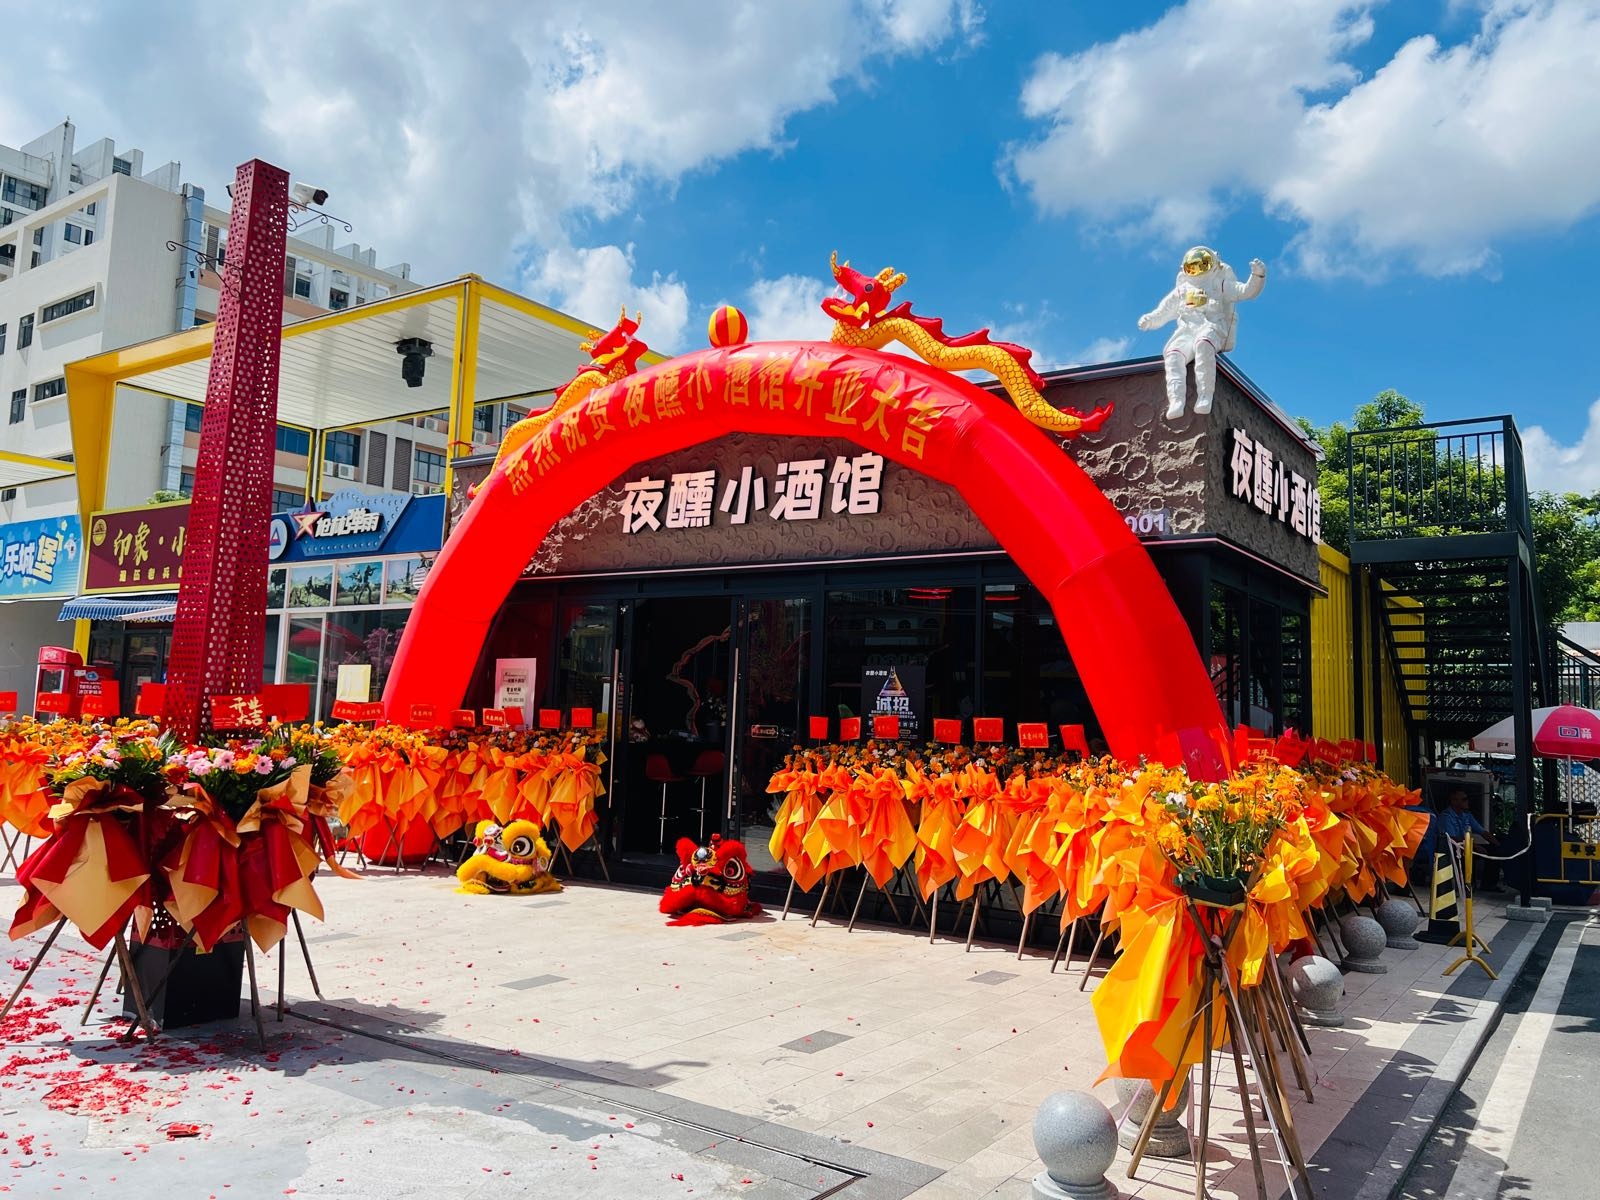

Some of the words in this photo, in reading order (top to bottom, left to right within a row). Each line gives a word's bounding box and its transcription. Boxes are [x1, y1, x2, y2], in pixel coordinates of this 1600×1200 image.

[622, 451, 884, 534] 夜醺小酒馆
[1231, 428, 1321, 545] 夜醺小酒馆
[0, 533, 60, 583] 乐城堡
[875, 696, 910, 712] 诚招
